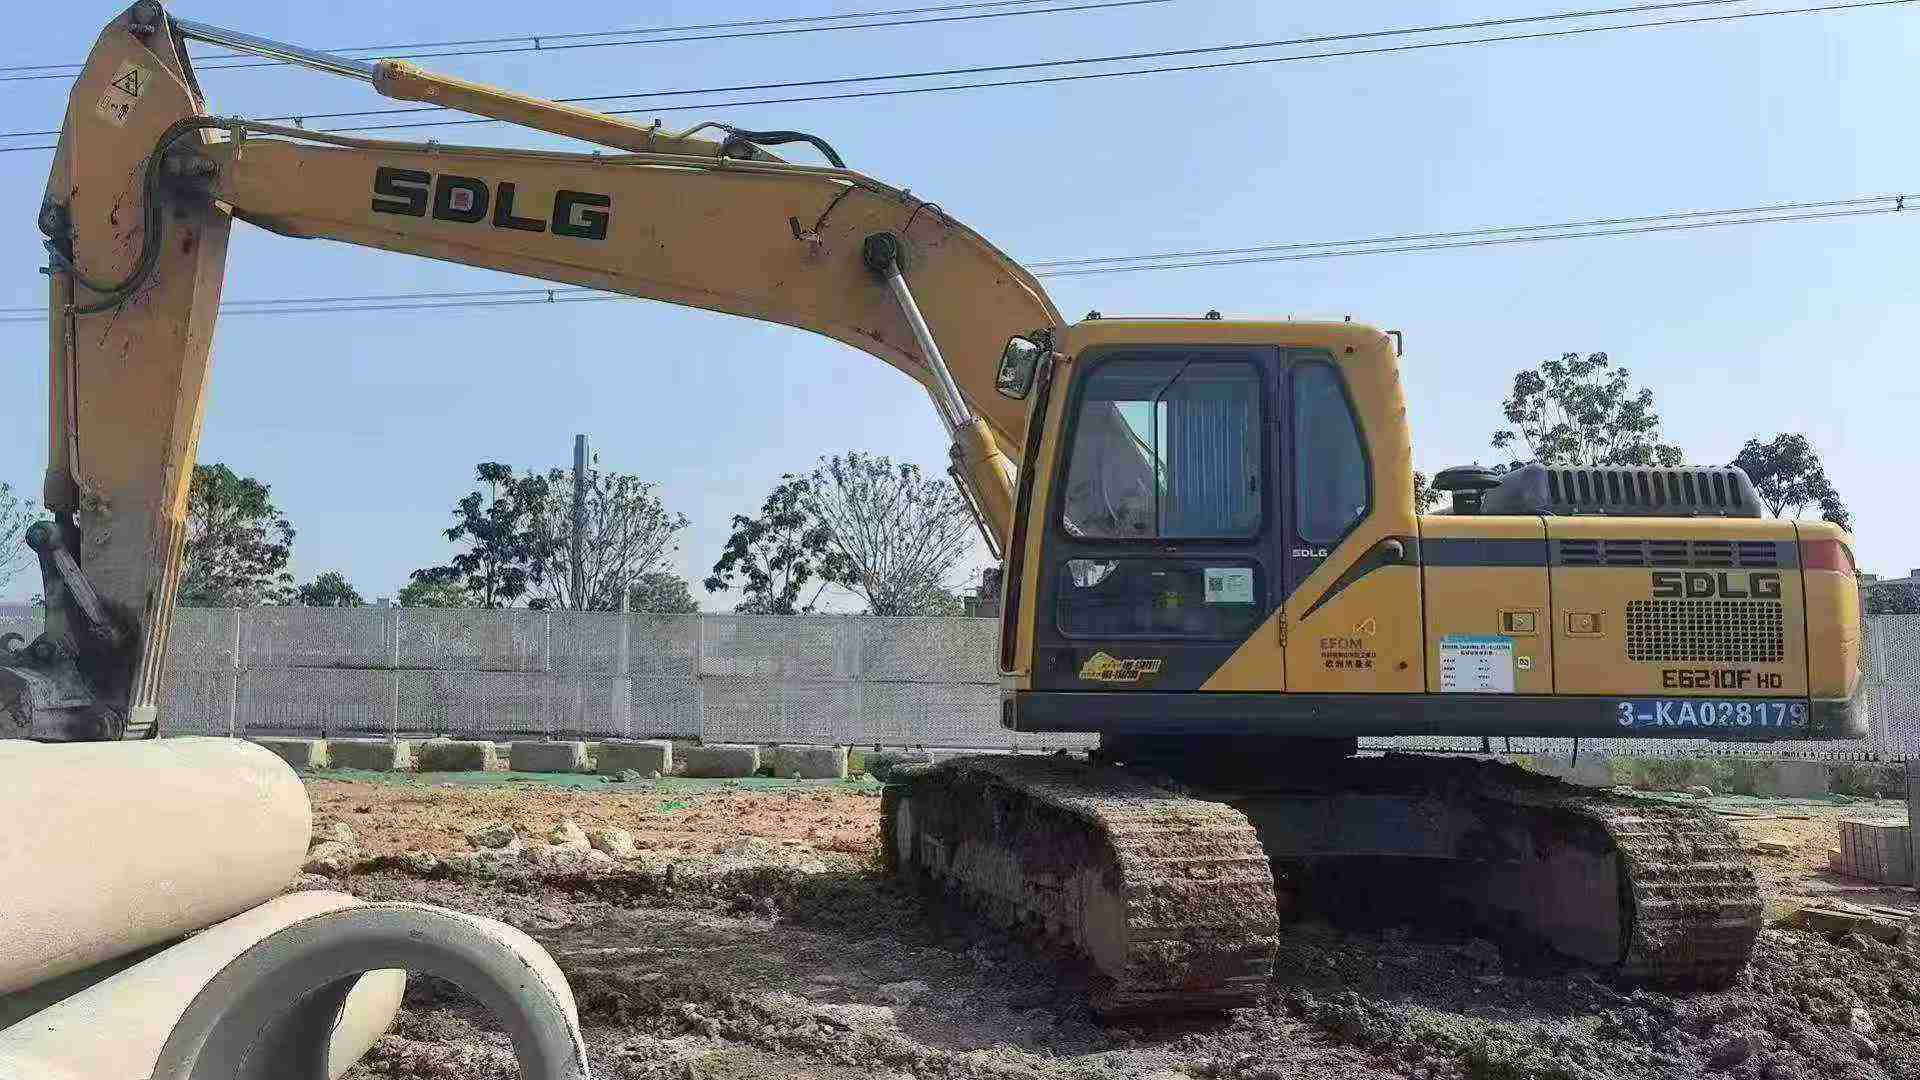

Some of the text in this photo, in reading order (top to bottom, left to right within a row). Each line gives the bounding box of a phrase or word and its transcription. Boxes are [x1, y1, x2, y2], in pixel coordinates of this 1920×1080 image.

[371, 166, 612, 241] SDLG
[1292, 548, 1329, 558] SDLG
[1652, 571, 1781, 600] SDLG
[1662, 669, 1783, 690] E6210F HD
[1617, 701, 1808, 728] 3-KA028179
